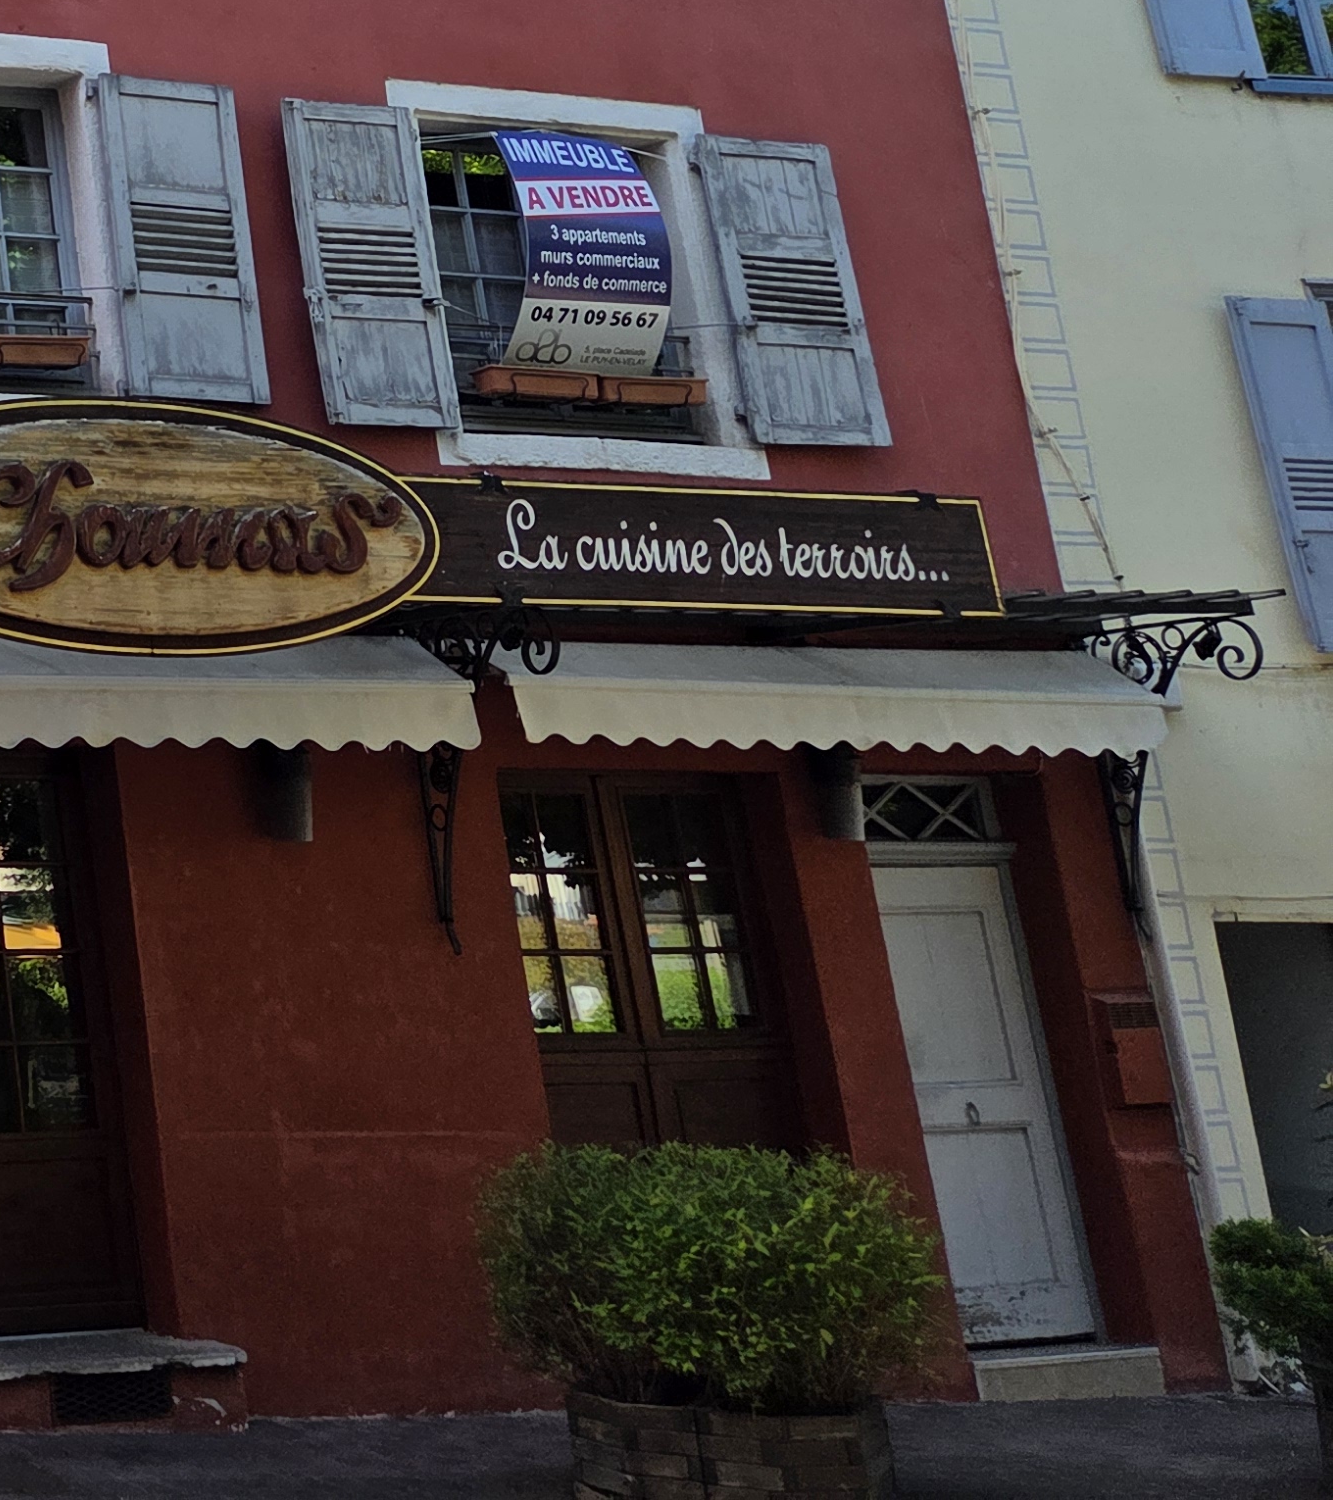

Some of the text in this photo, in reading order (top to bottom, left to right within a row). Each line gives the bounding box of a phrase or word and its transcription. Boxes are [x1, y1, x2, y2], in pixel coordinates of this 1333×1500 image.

[502, 137, 635, 173] IMMEUBLE
[528, 185, 653, 210] A VENDRE
[550, 224, 647, 245] 3 appartements
[540, 250, 660, 269] murs commerciaux
[543, 270, 579, 288] fonds
[583, 273, 599, 290] de
[601, 278, 667, 293] commerce
[531, 306, 659, 328] 04 71 09 56 67
[497, 498, 950, 583] La cuisine des terroirs...
